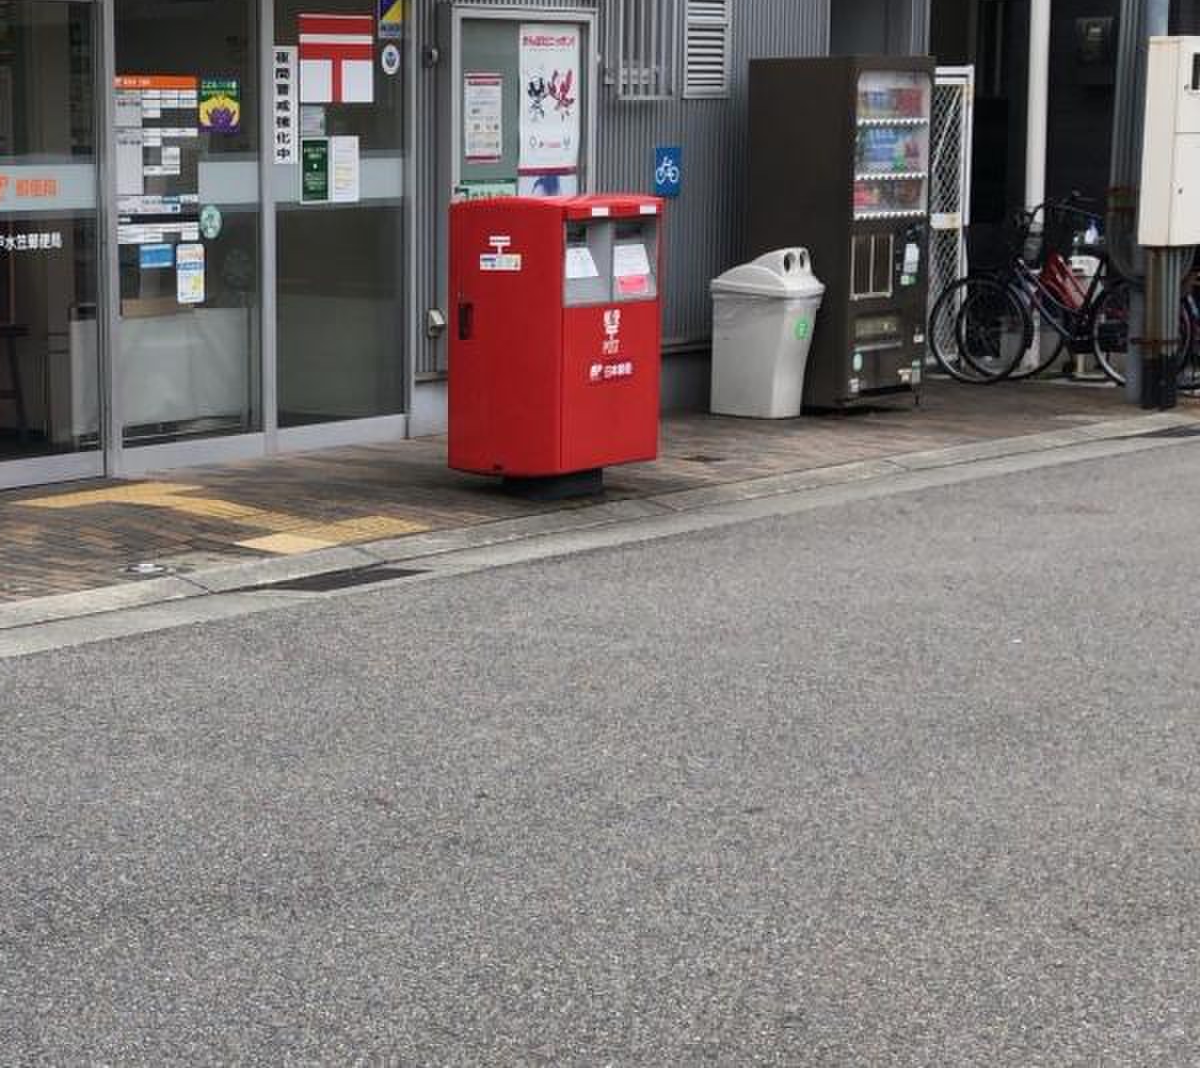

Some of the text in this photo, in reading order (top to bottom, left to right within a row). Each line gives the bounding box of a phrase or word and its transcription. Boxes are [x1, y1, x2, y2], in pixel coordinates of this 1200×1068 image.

[275, 50, 292, 160] 夜間警戒強化中
